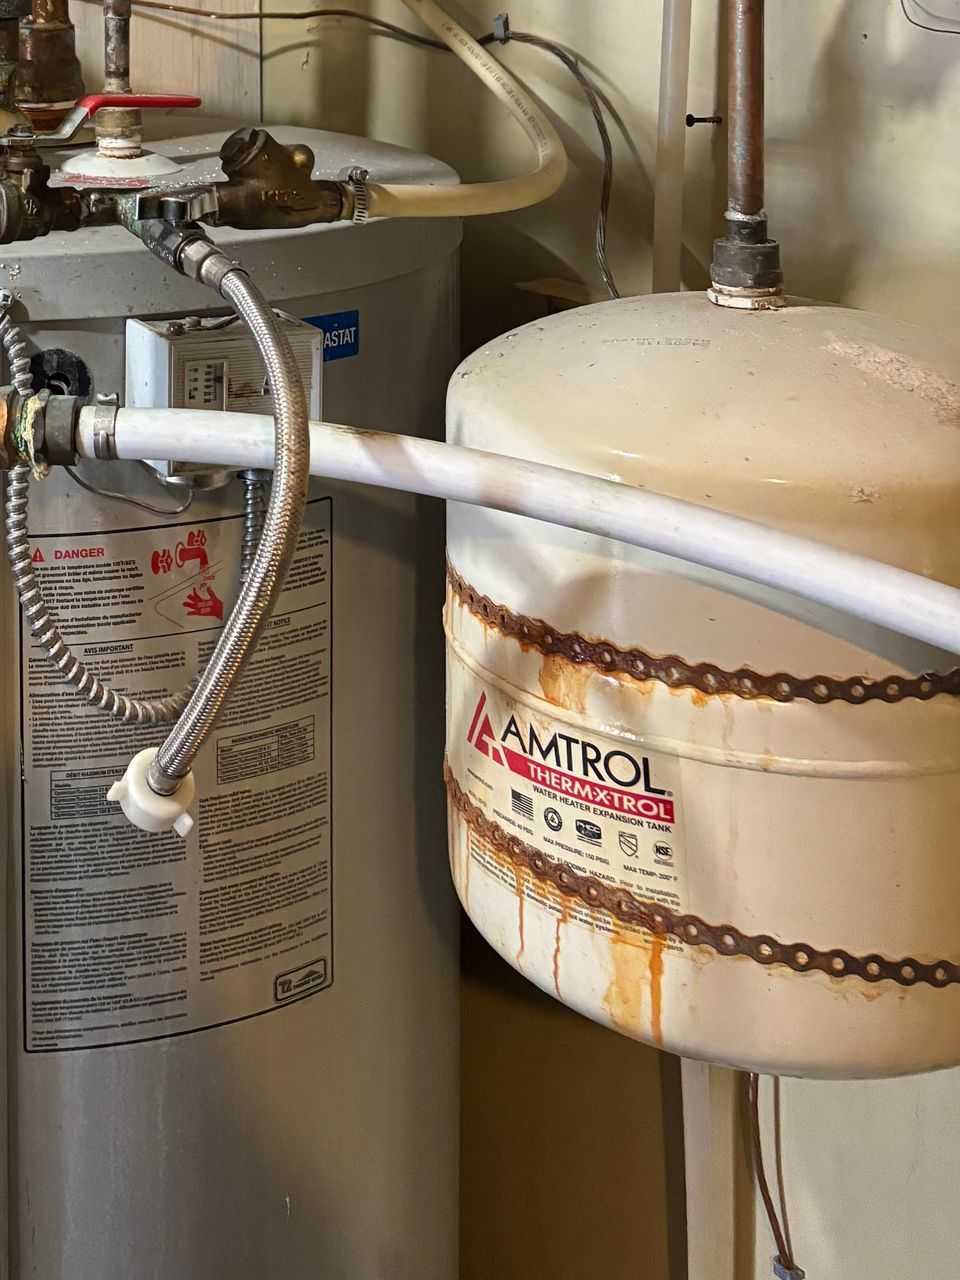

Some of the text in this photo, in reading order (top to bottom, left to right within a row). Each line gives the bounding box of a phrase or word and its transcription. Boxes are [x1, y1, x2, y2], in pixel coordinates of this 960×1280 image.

[324, 327, 356, 348] ASTAT
[54, 548, 105, 560] DANGER
[84, 644, 133, 654] AVIS IMPORTANT
[501, 714, 666, 796] AMTROL
[532, 784, 672, 833] WATER HEATER EXPANSION TANK
[543, 836, 554, 845] MAX
[555, 841, 584, 857] PRESSURE:
[623, 865, 637, 873] MAX
[638, 868, 658, 878] TEMP:
